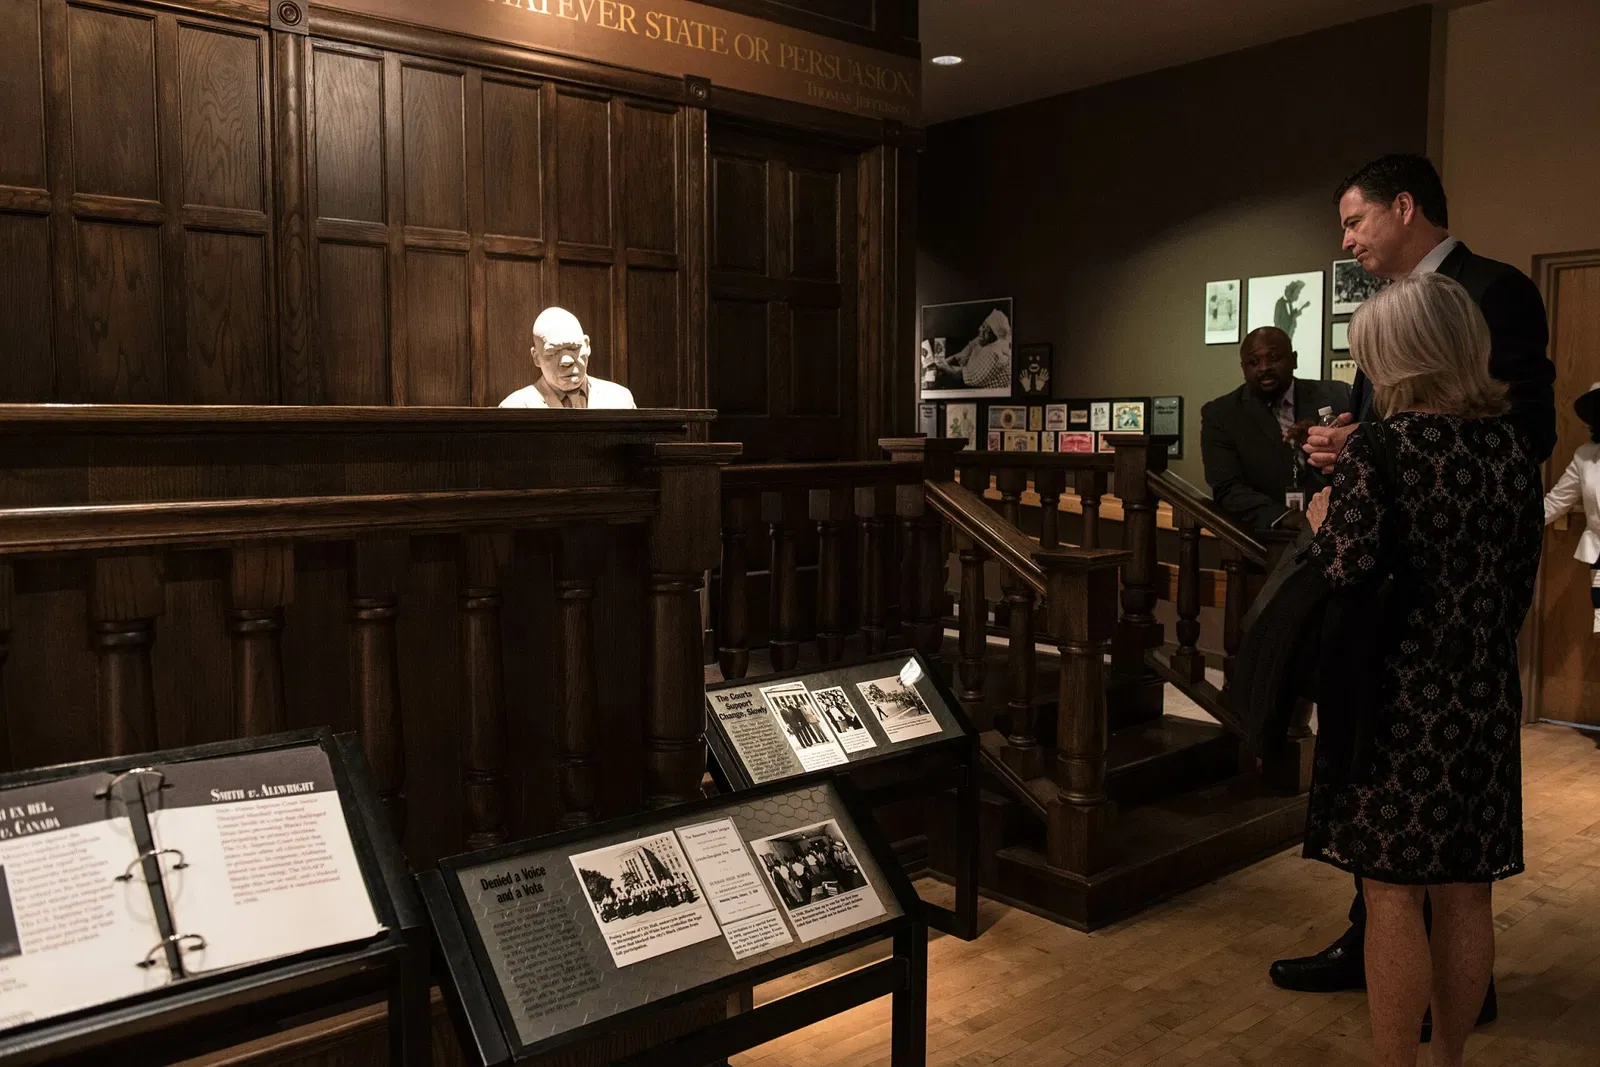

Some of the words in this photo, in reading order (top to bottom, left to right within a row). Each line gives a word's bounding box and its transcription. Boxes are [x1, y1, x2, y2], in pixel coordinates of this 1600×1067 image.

[645, 11, 729, 56] STATE
[733, 33, 771, 65] OR
[715, 694, 729, 703] The
[729, 690, 753, 701] Courts
[725, 699, 753, 711] Support
[718, 710, 747, 721] Change,
[747, 706, 768, 717] Slowly
[210, 788, 245, 802] SMITH
[248, 788, 260, 799] v.
[261, 780, 315, 797] ALLWRIGHT
[480, 871, 514, 891] Denied
[514, 873, 522, 883] a
[521, 865, 547, 884] Voice
[496, 889, 514, 904] and
[515, 888, 523, 899] a
[522, 881, 545, 897] Vote
